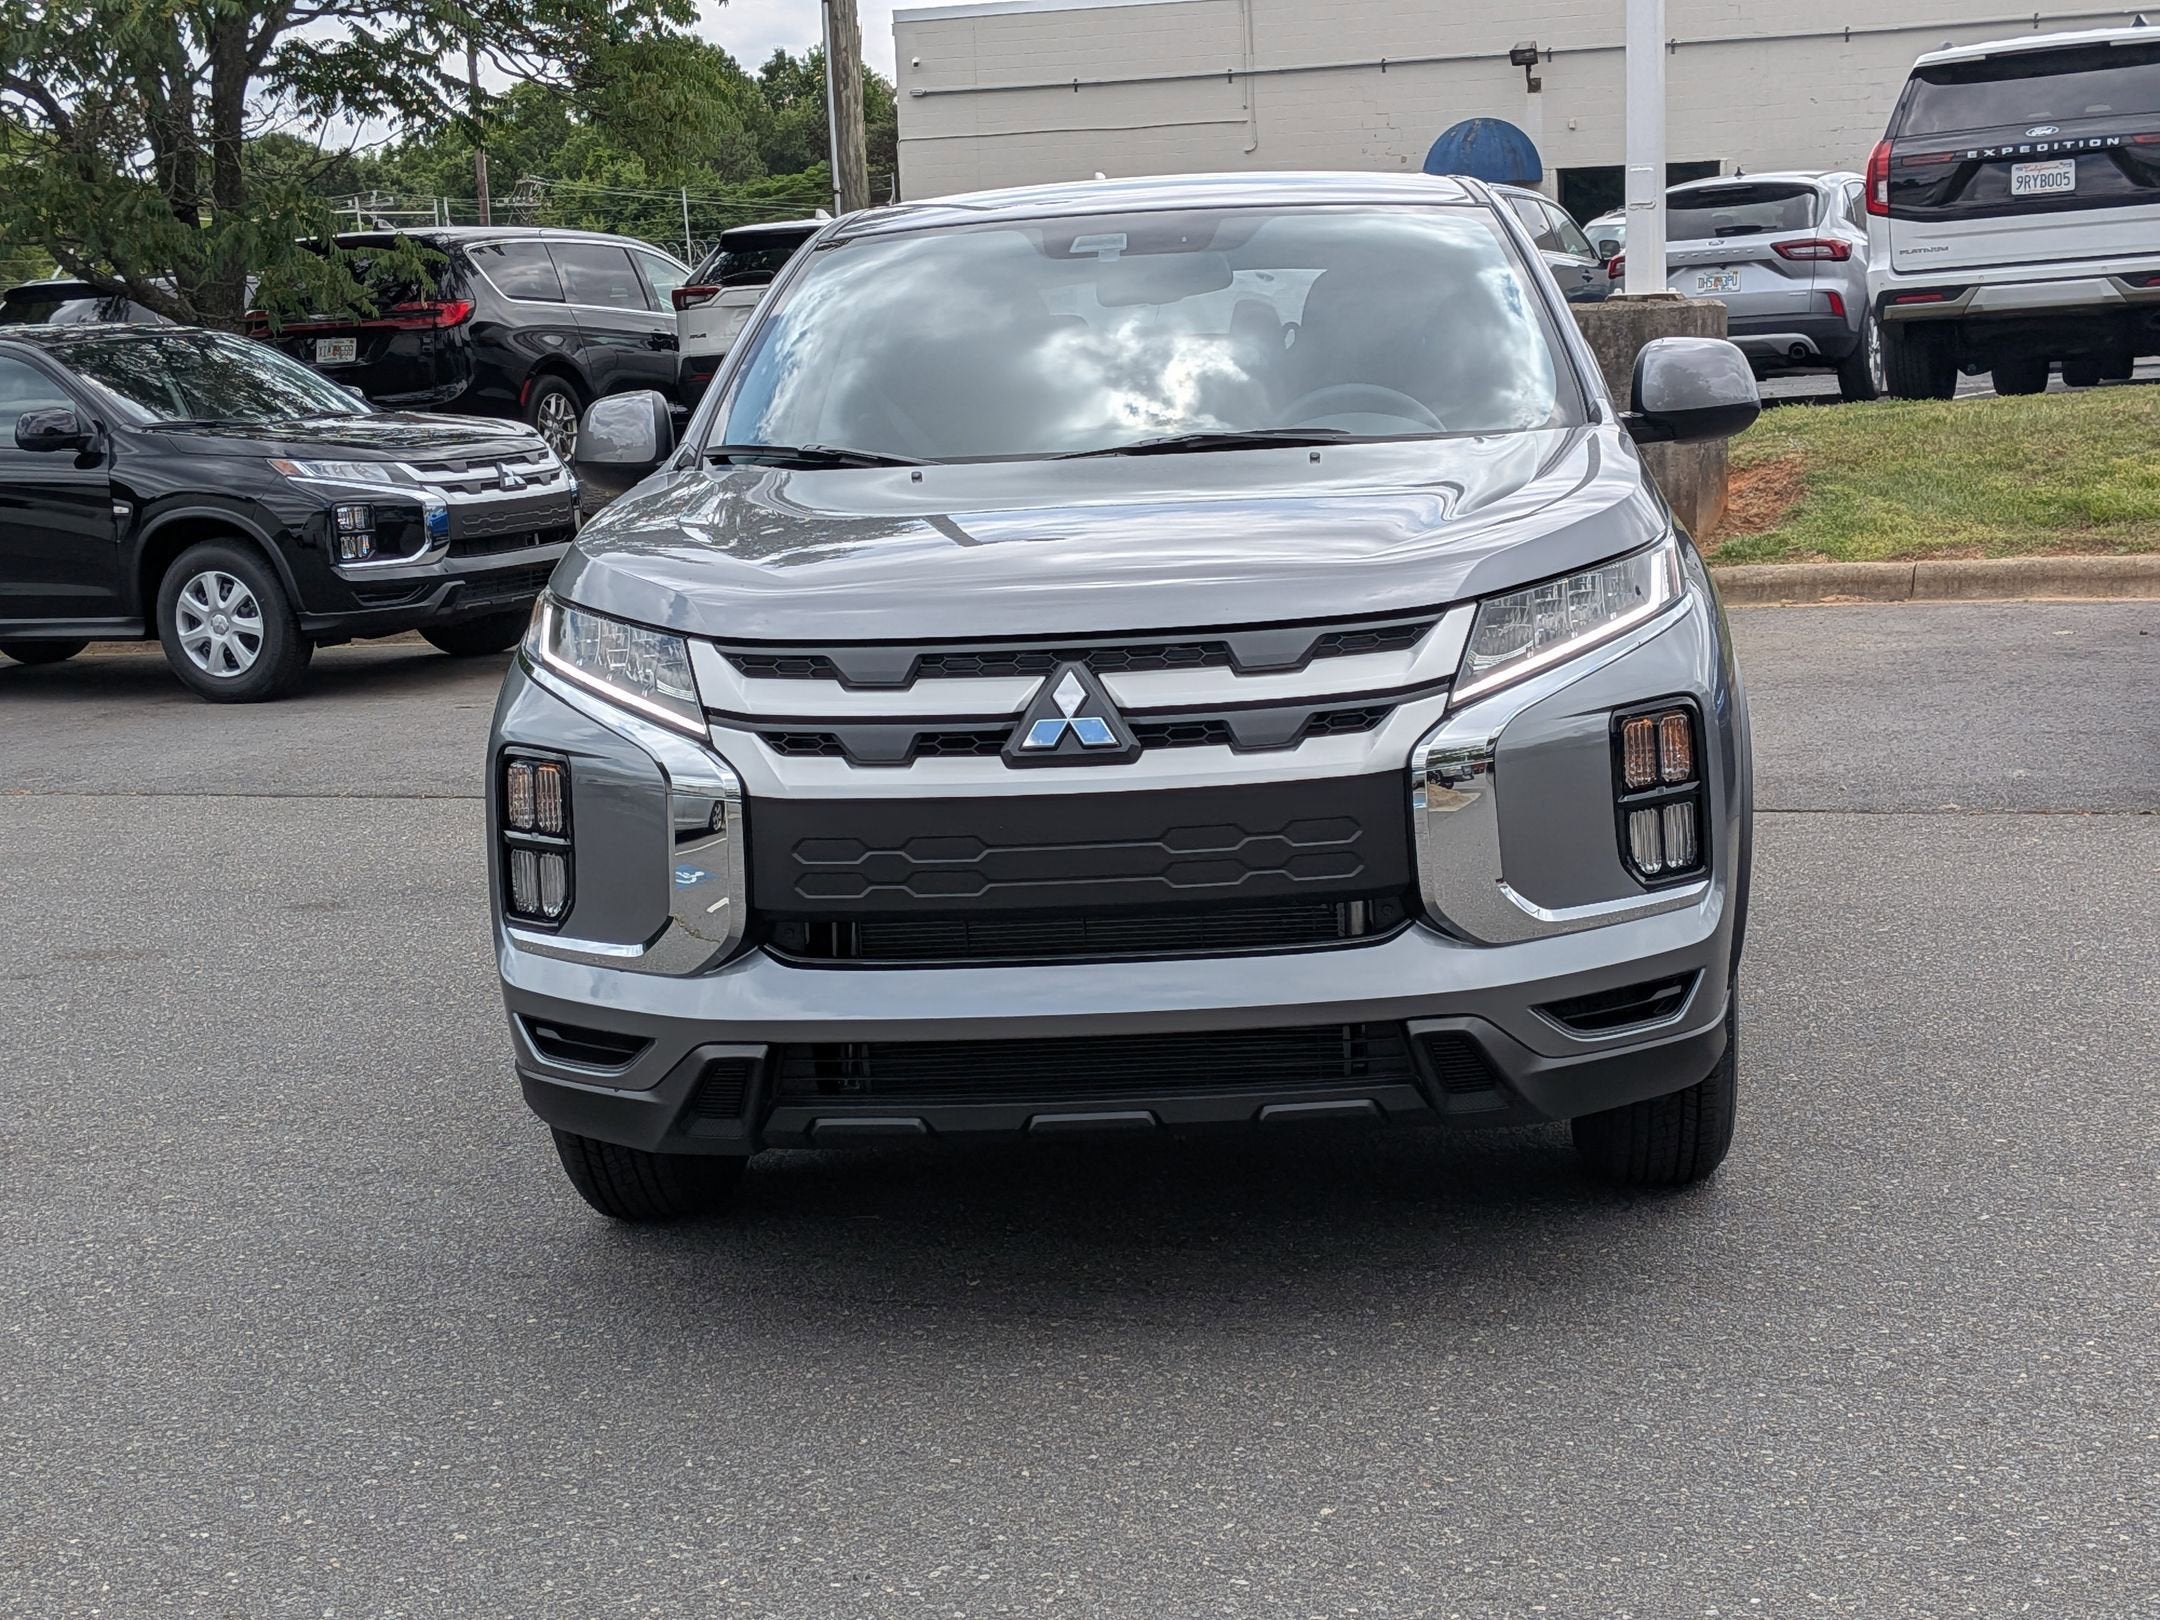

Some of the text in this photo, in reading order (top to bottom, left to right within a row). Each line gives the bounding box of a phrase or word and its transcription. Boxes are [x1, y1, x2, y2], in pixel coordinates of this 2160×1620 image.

[1967, 137, 2120, 159] EXPEDITION
[2016, 171, 2070, 192] 9RYB005
[1899, 246, 1949, 256] PLATINUM
